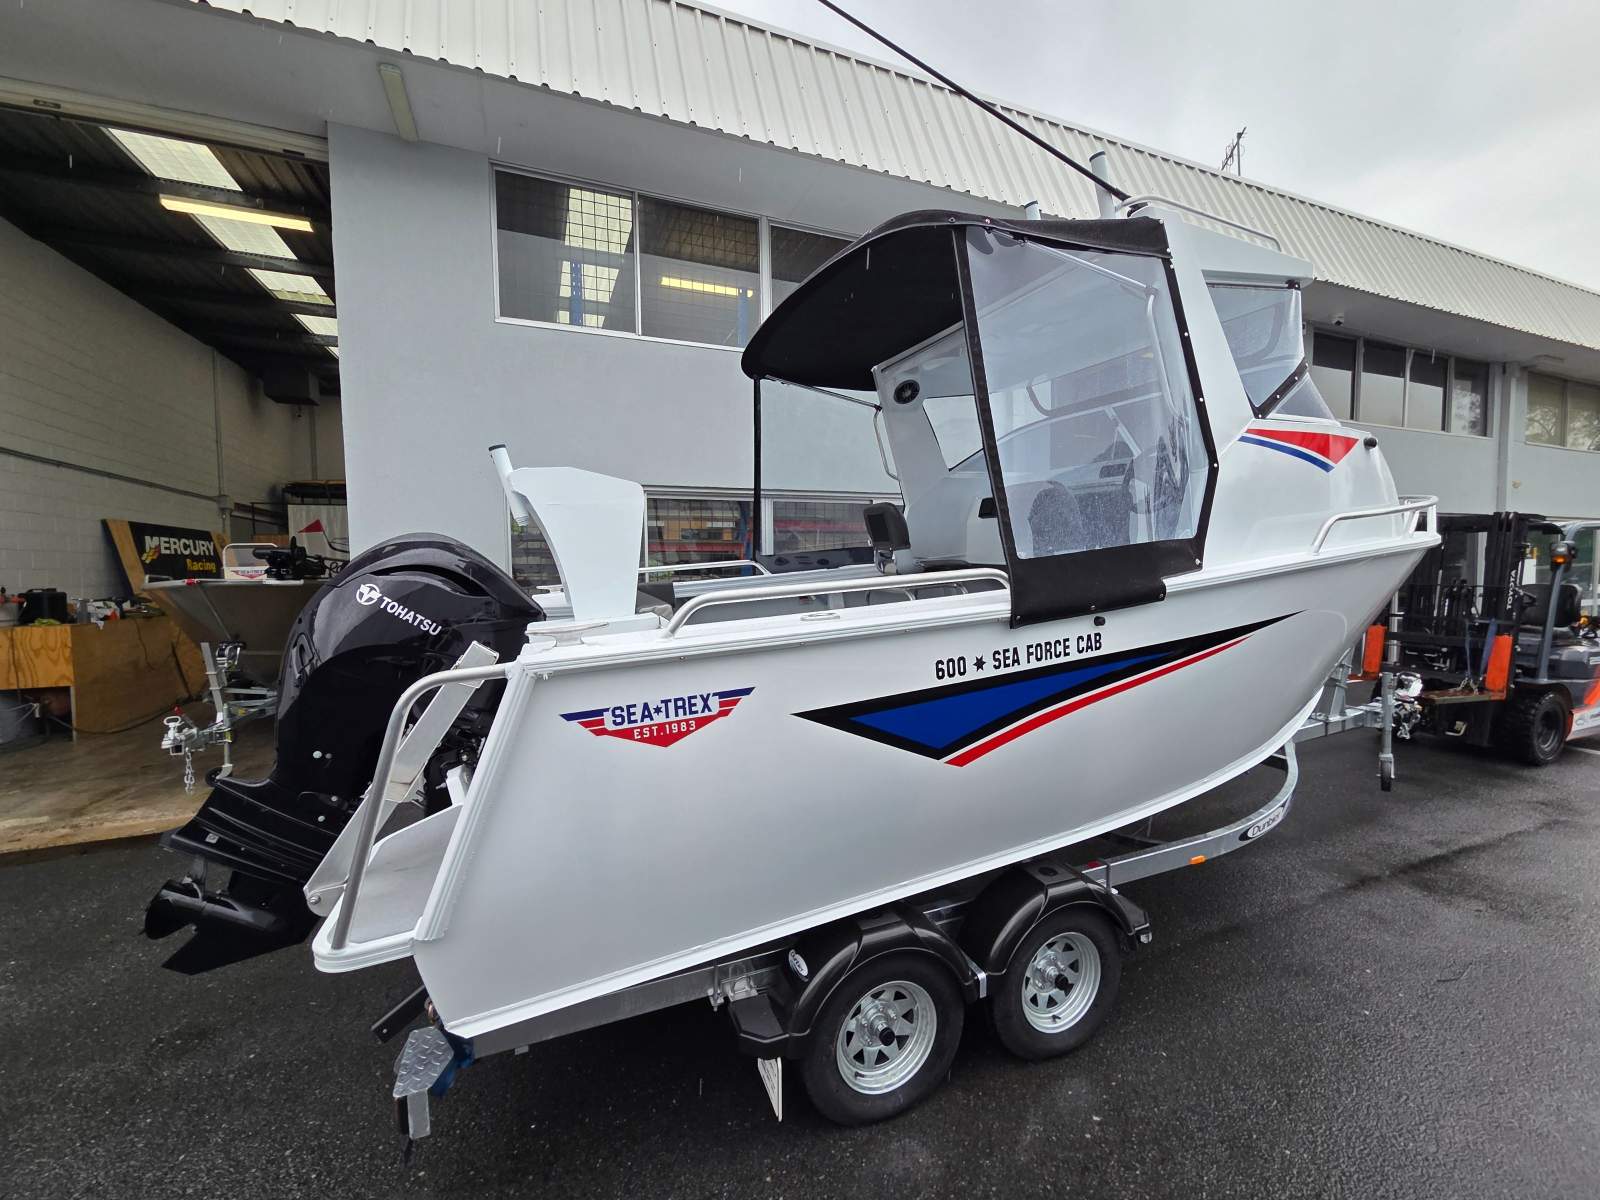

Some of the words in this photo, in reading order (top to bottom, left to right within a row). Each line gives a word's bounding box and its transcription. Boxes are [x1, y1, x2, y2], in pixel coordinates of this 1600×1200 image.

[143, 535, 214, 556] MERCURY
[186, 558, 217, 573] Racing
[1506, 569, 1517, 610] TOYOTA
[380, 596, 442, 636] TOHATSU
[935, 655, 967, 681] 600
[992, 646, 1021, 670] SEA
[1026, 637, 1070, 664] FORCE
[1076, 632, 1103, 655] CAB
